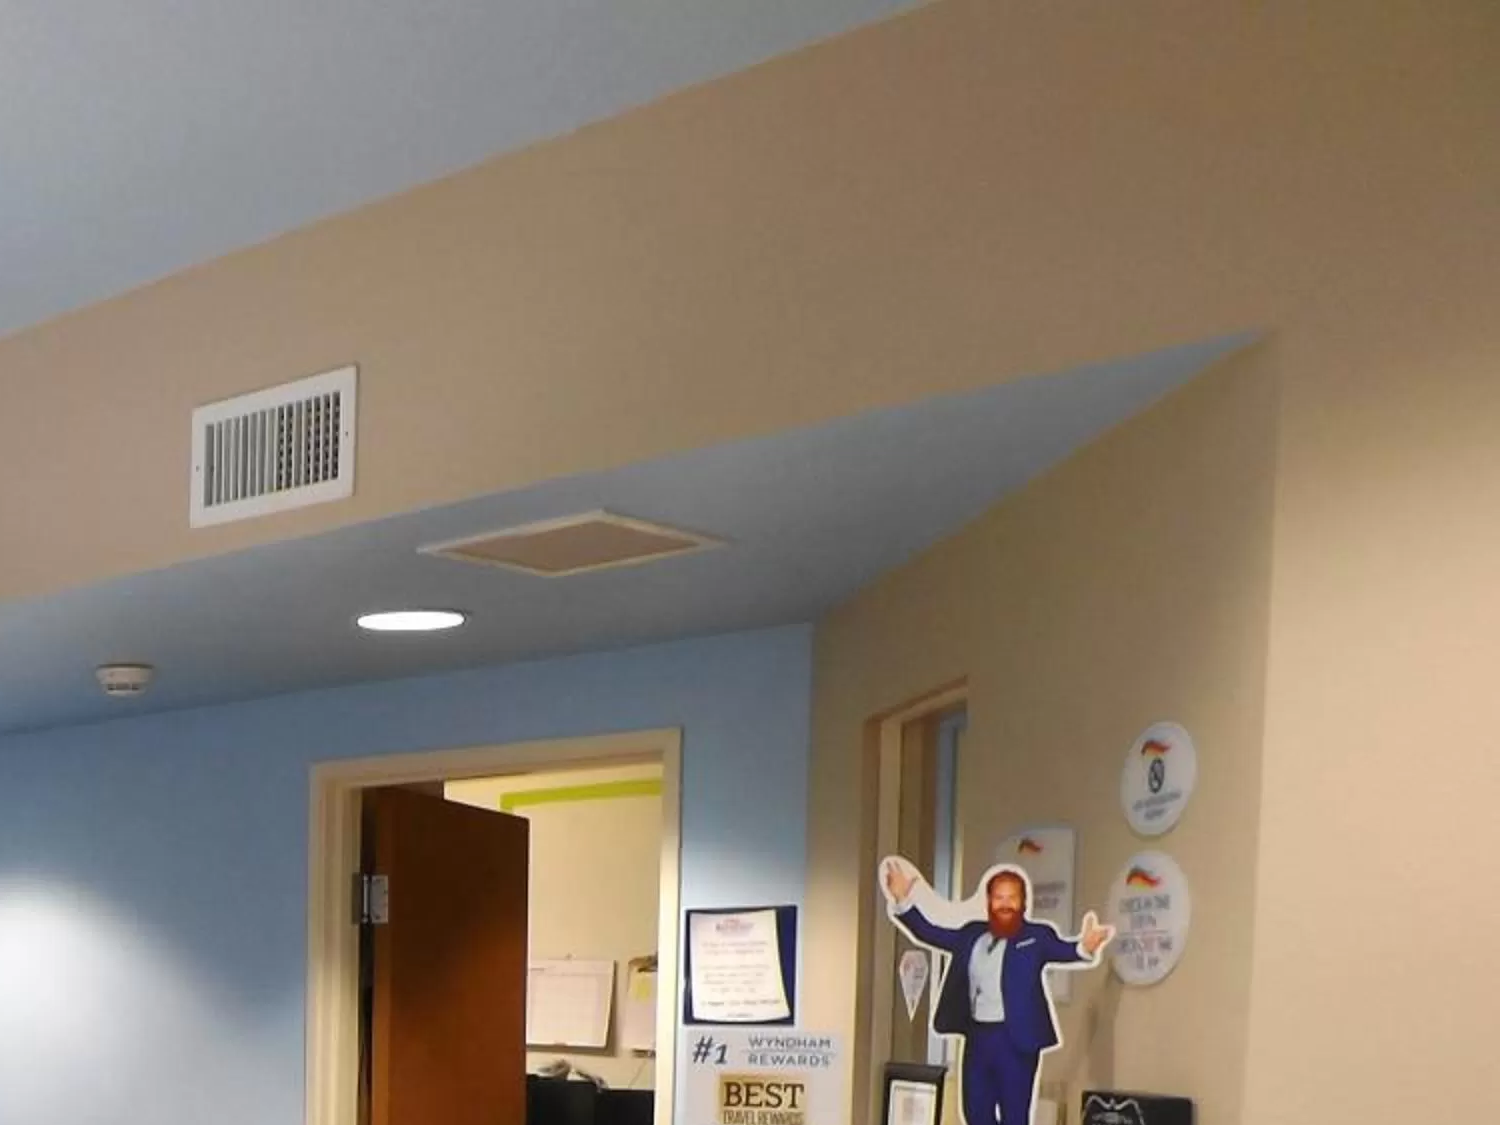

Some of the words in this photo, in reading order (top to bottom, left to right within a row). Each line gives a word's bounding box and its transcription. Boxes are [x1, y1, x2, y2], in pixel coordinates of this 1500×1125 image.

[693, 1035, 728, 1065] #1
[747, 1036, 832, 1049] WYNDHAM
[747, 1054, 830, 1067] REWARDS
[723, 1081, 805, 1109] BEST
